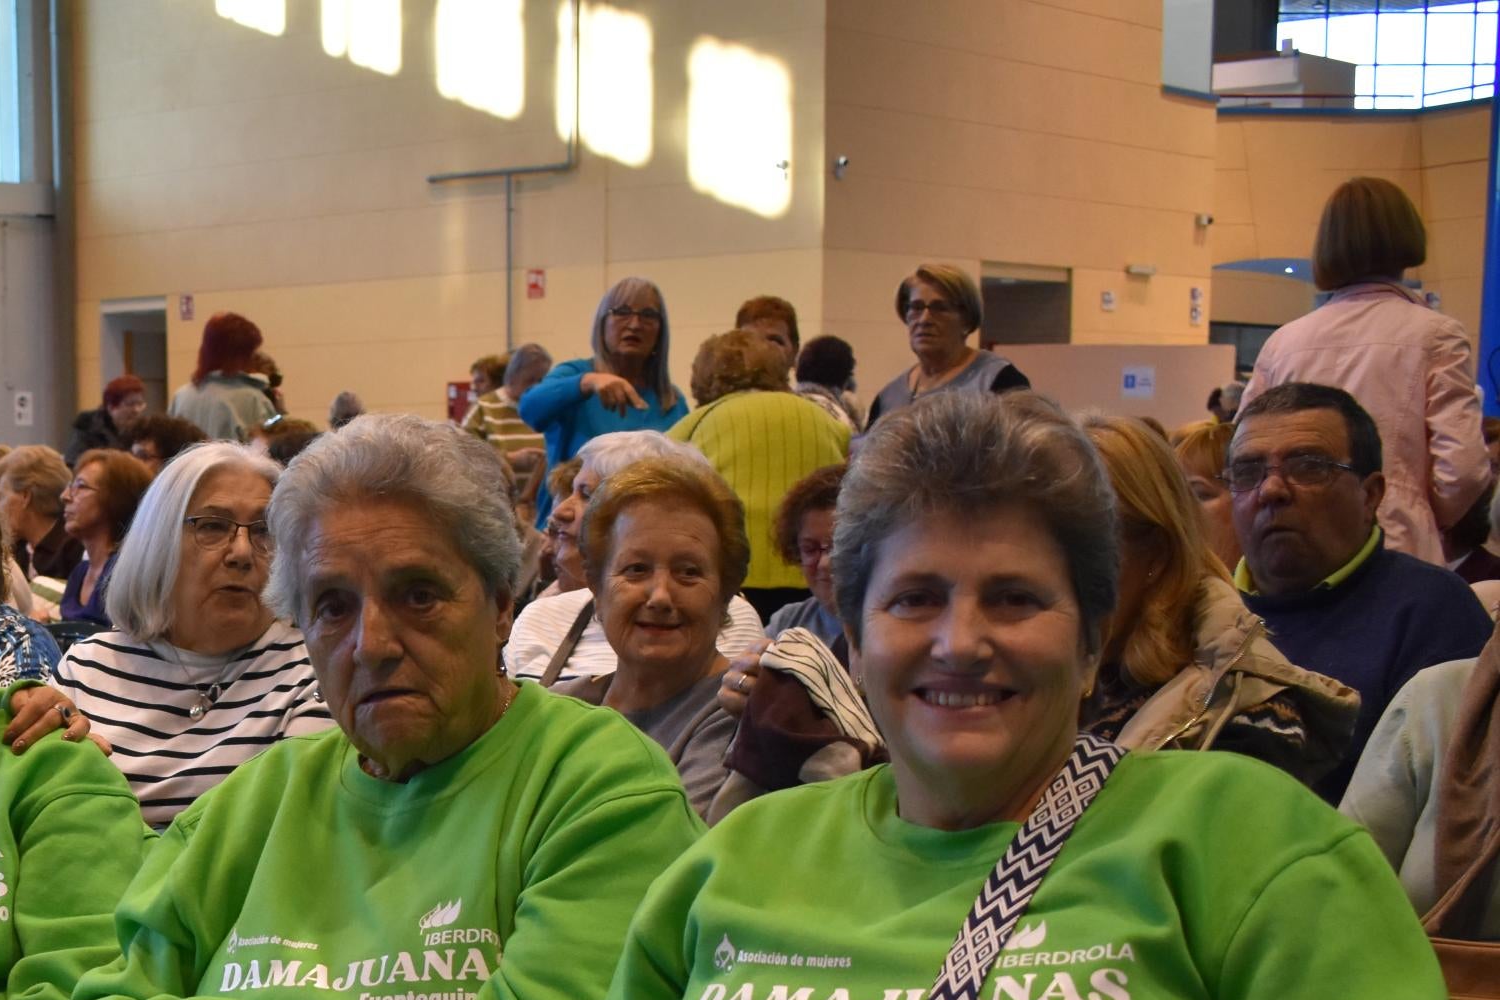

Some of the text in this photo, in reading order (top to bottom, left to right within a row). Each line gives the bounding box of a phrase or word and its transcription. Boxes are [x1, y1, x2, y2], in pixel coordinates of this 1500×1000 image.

[737, 949, 852, 969] Asociación de mujeres
[995, 942, 1135, 969] IBERDROLA
[219, 947, 502, 993] DAMAJUANA
